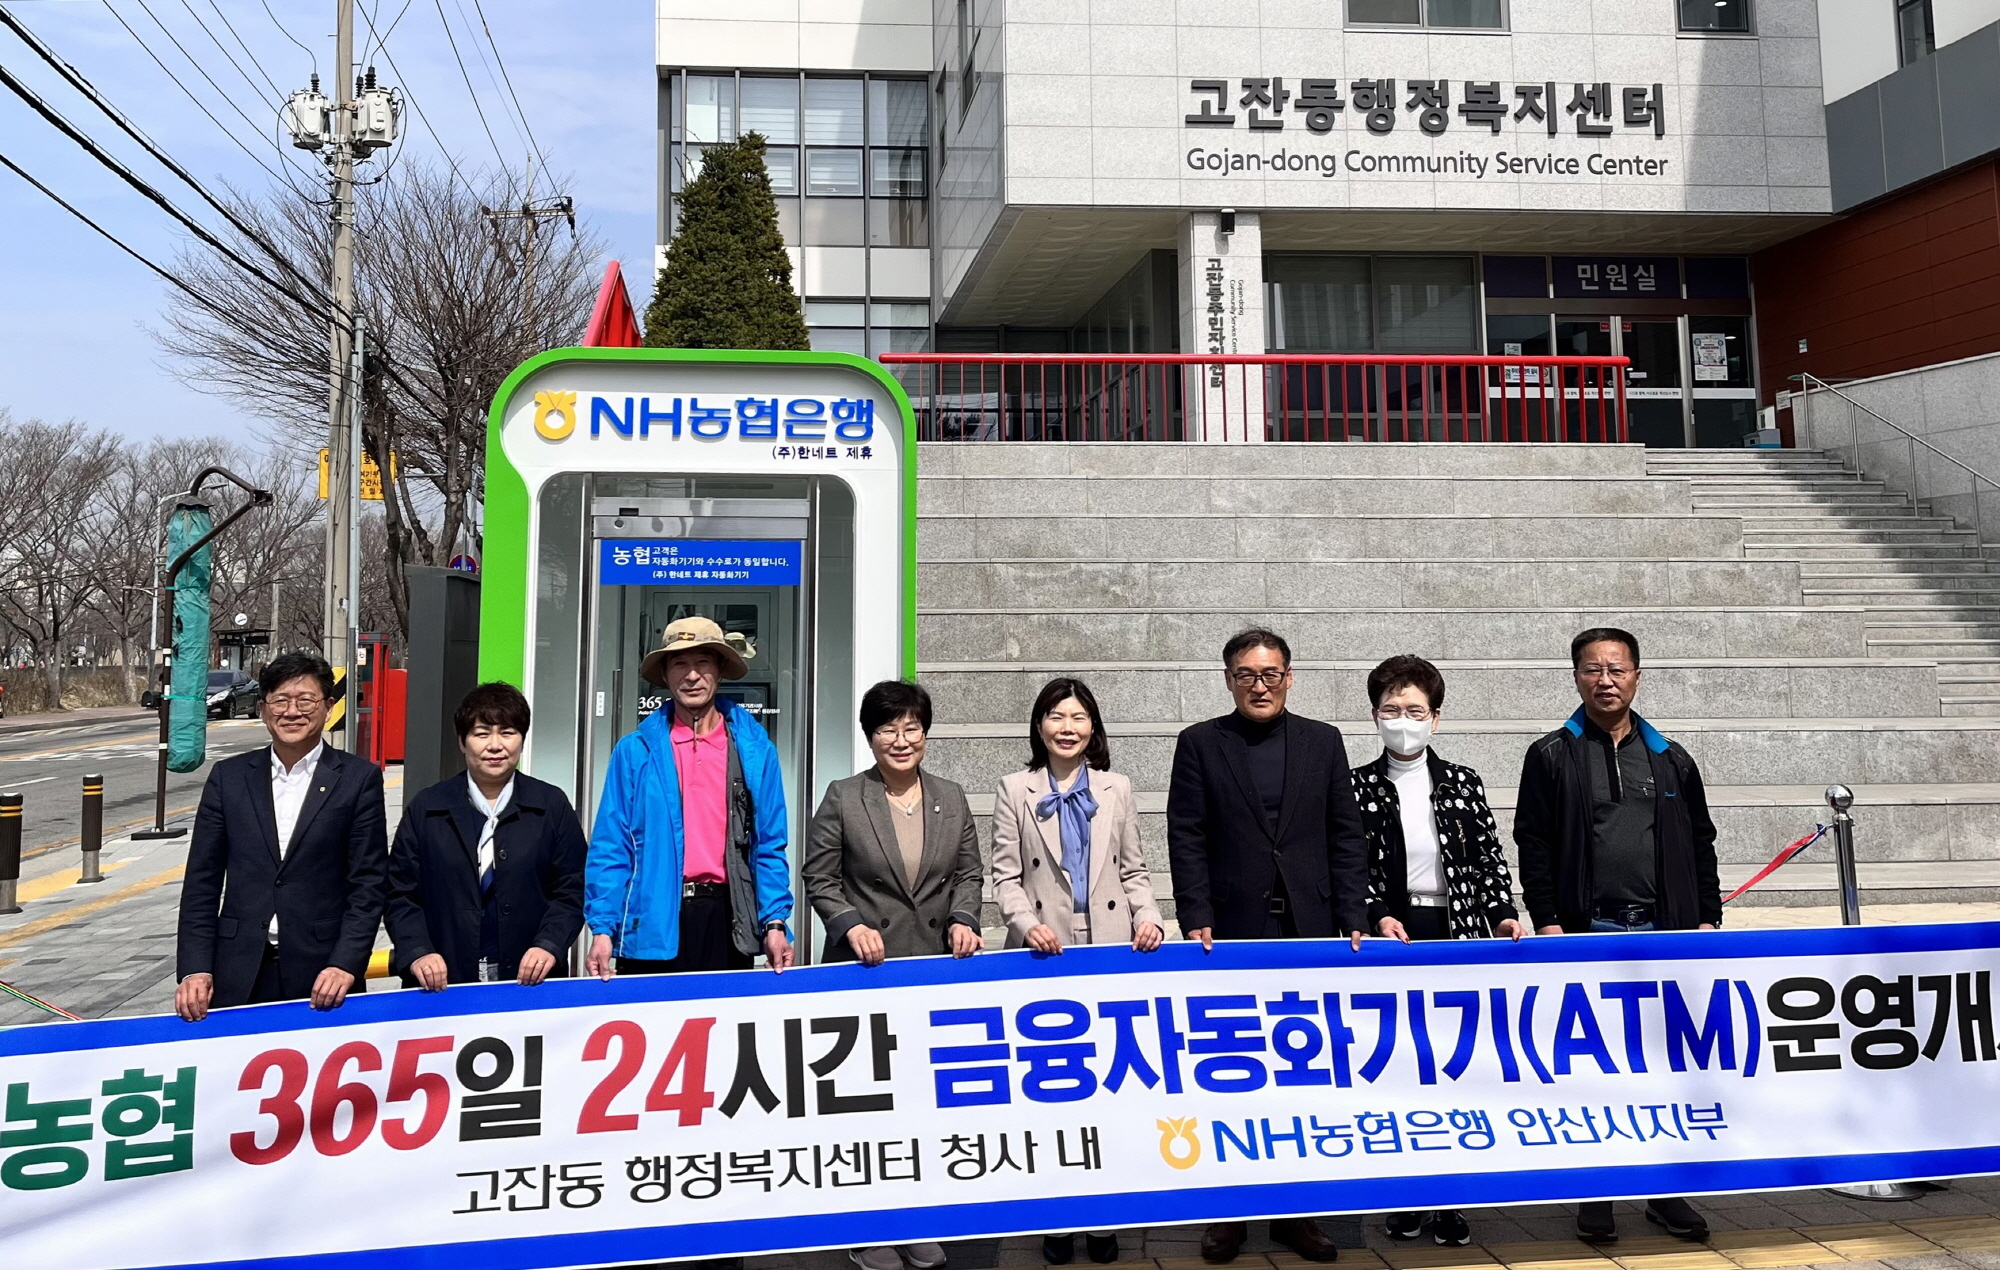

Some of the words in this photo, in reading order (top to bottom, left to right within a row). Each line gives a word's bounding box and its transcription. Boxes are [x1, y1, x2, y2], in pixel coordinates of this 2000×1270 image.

[1185, 77, 1666, 137] 고잔동행정복지센터
[1187, 147, 1336, 178] Gojan-dong
[1344, 149, 1489, 179] Community
[1495, 151, 1580, 175] Service
[1587, 153, 1669, 176] Center
[1577, 264, 1657, 291] 민원실
[591, 396, 874, 440] NH농협은행
[772, 445, 838, 460] (주)한네트
[846, 445, 873, 460] 제휴
[612, 546, 650, 566] 농협
[652, 546, 678, 556] 고객은
[652, 557, 704, 566] 자동화기기와
[706, 557, 742, 566] 수수료가
[743, 557, 790, 567] 동일합니다.
[652, 570, 667, 579] (주)
[668, 570, 692, 579] 한네트
[693, 570, 709, 579] 제휴
[711, 570, 749, 580] 자동화기기
[637, 695, 662, 710] 365
[1, 1065, 197, 1191] 농협
[229, 1035, 543, 1166] 365일
[577, 1012, 898, 1135] 24시간
[452, 1161, 606, 1216] 고잔동
[625, 1138, 922, 1202] 행정복지센터
[940, 1130, 1039, 1181] 청사
[1056, 1126, 1102, 1170] 내
[1211, 1109, 1496, 1163] NH농협은행
[1517, 1102, 1728, 1147] 안산시지부
